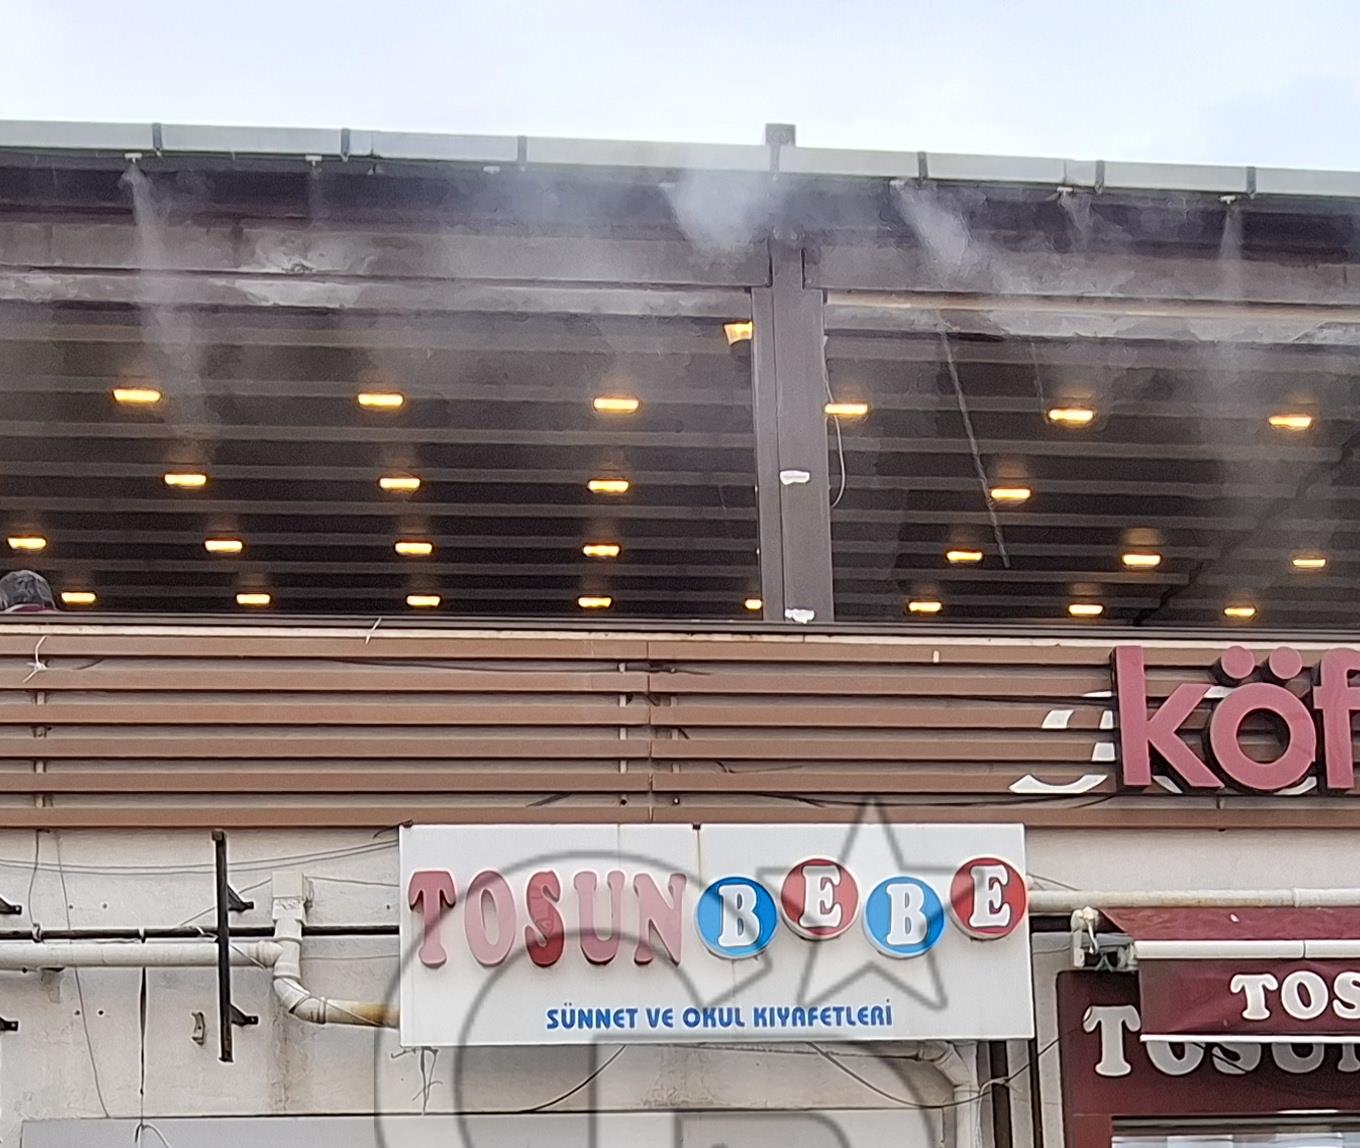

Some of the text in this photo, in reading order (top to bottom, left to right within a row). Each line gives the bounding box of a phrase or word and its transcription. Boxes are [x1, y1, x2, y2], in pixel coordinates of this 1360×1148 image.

[408, 862, 1014, 968] TOSUN BEBE
[545, 998, 894, 1030] SÜNNET VE OKUL KIYAFETLERİ
